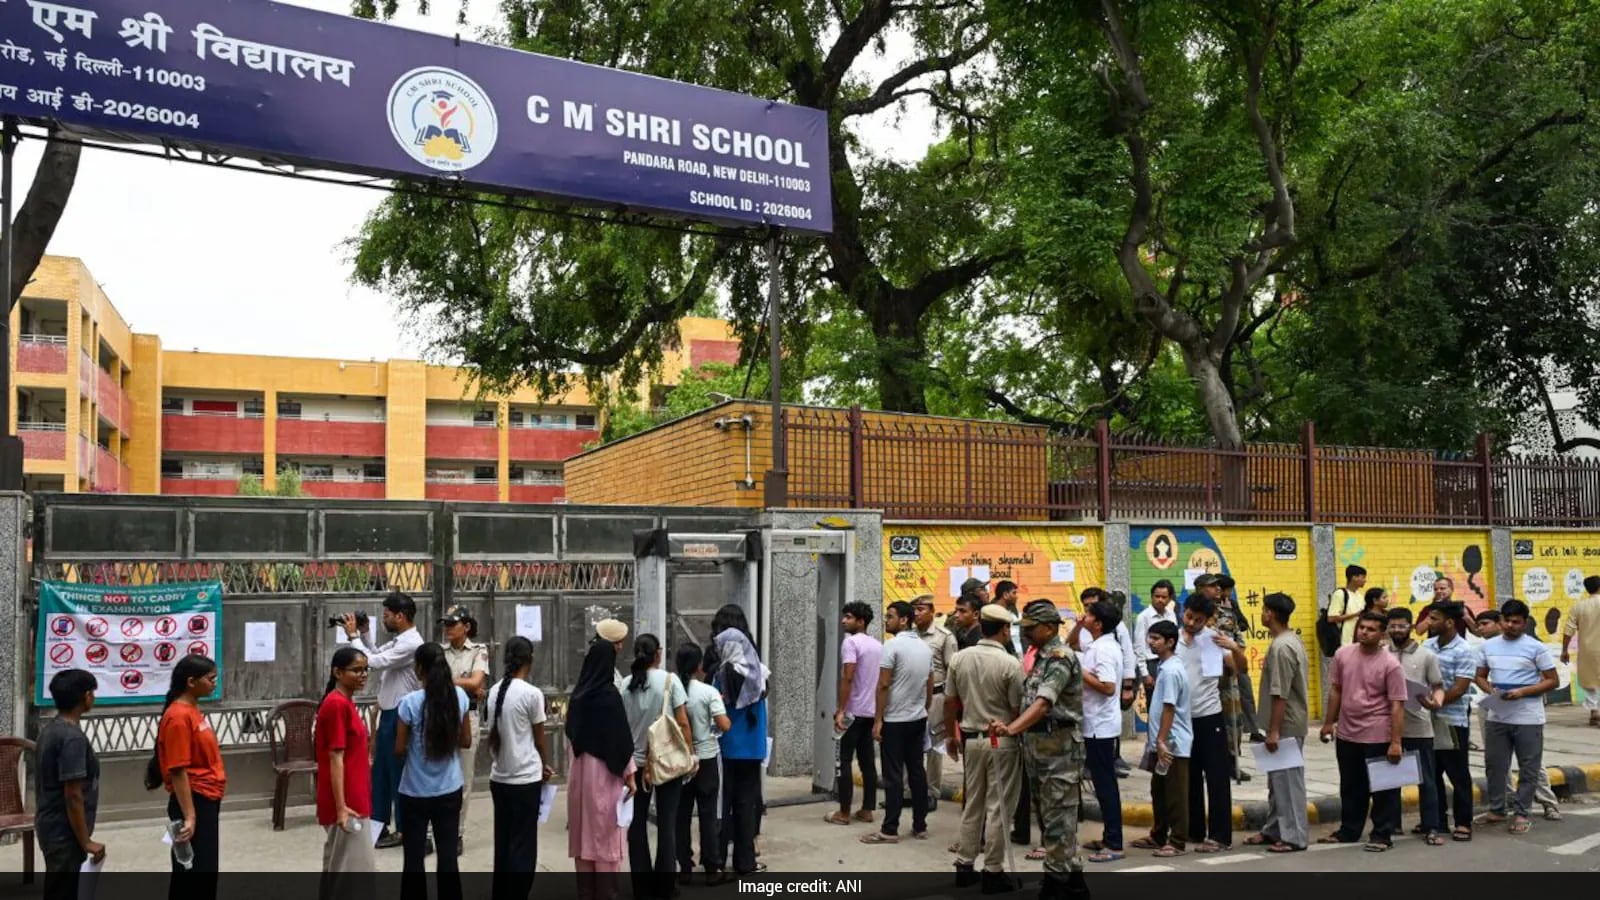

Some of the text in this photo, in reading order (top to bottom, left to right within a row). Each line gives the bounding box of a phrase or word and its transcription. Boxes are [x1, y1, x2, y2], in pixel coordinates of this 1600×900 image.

[30, 0, 355, 87] एम श्री विद्यालय
[44, 48, 67, 71] नई
[75, 53, 206, 92] दिल्ली-110003
[26, 86, 62, 109] आई
[71, 92, 200, 128] डी-2026004
[527, 95, 810, 168] C M SHRI SCHOOL
[623, 151, 811, 192] PANDARA ROAD, NEW DELHI-110003
[690, 190, 737, 211] SCHOOL
[740, 198, 753, 212] ID
[763, 201, 812, 220] 2026004
[61, 591, 186, 604] THINGS NOT TO CARRY
[92, 604, 171, 614] EXAMINATION
